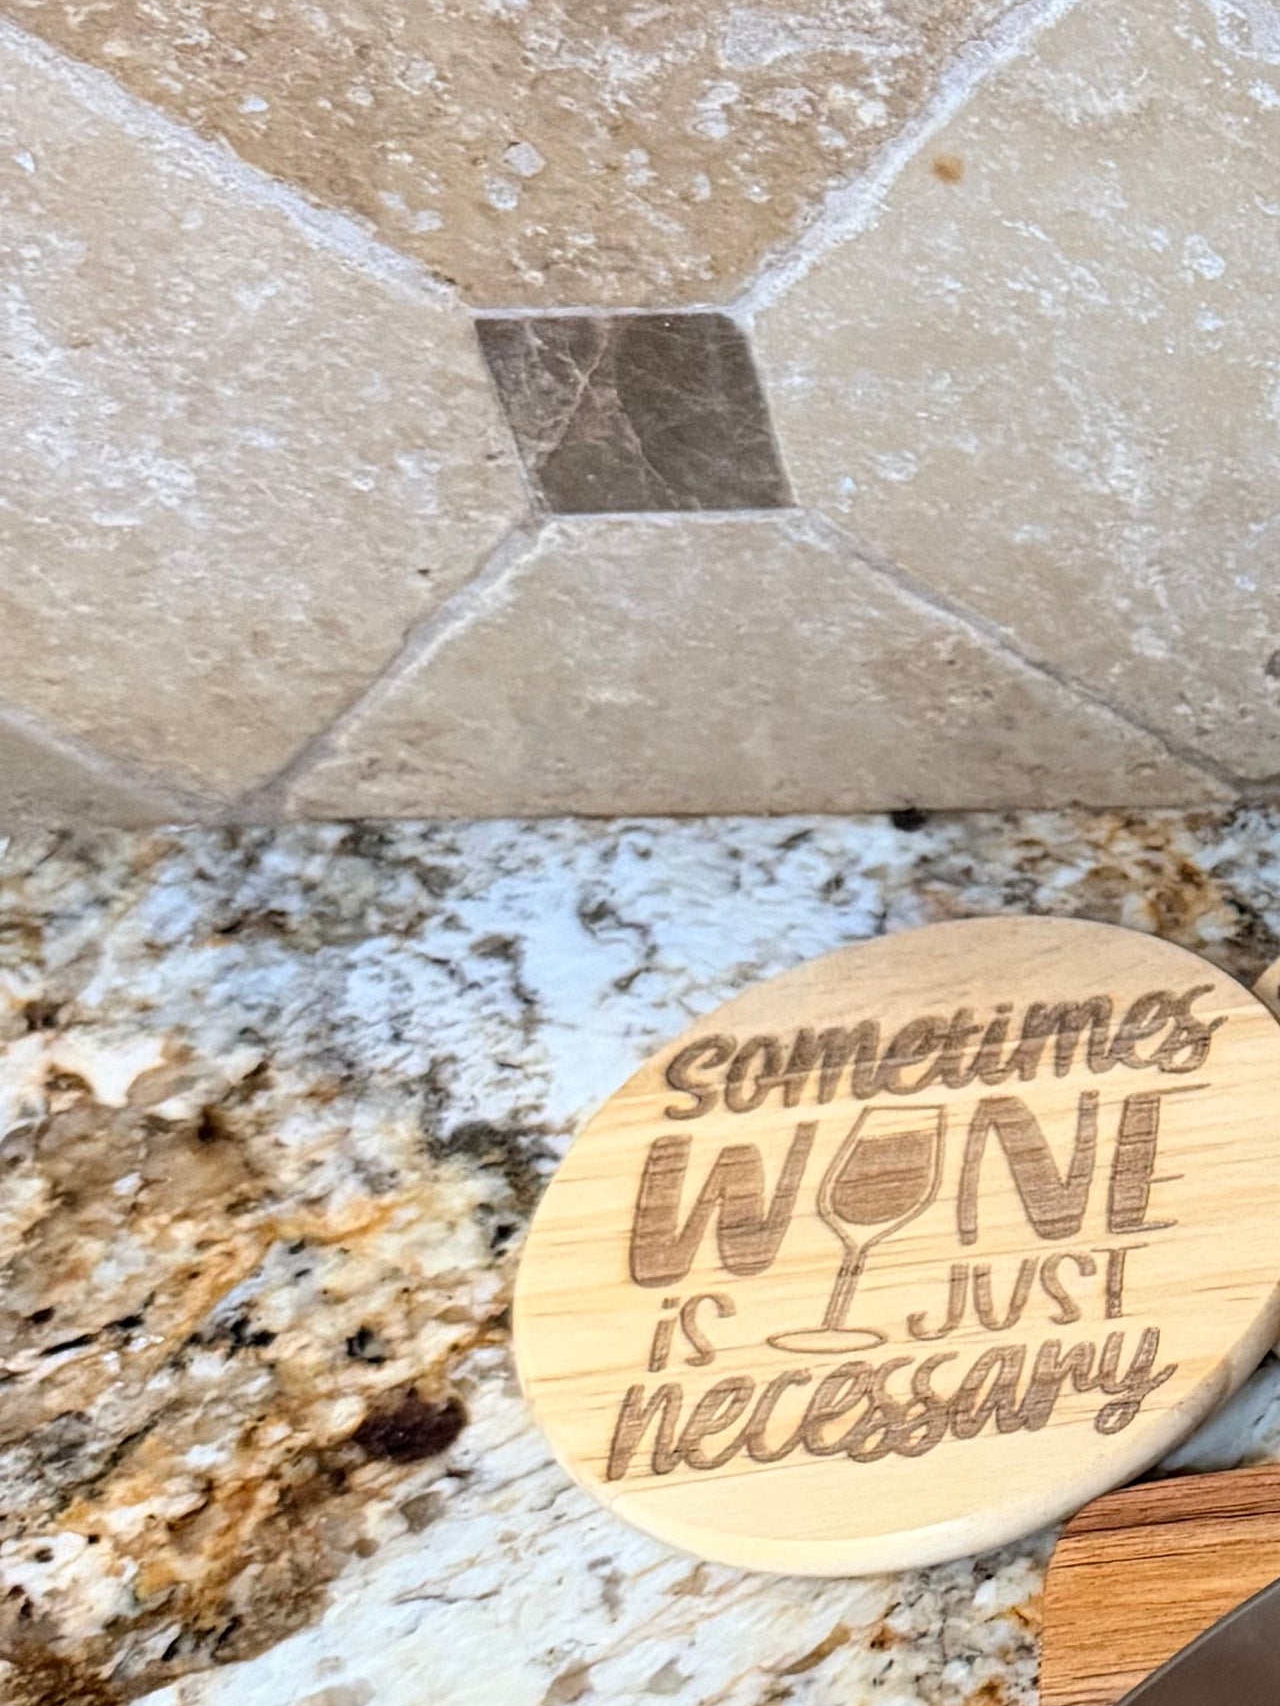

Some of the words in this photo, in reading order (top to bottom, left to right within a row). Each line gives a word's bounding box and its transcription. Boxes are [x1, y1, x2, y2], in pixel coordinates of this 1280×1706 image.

[664, 983, 1228, 1121] sometimes
[908, 1243, 1149, 1339] JUST
[606, 1326, 1178, 1481] necessary
